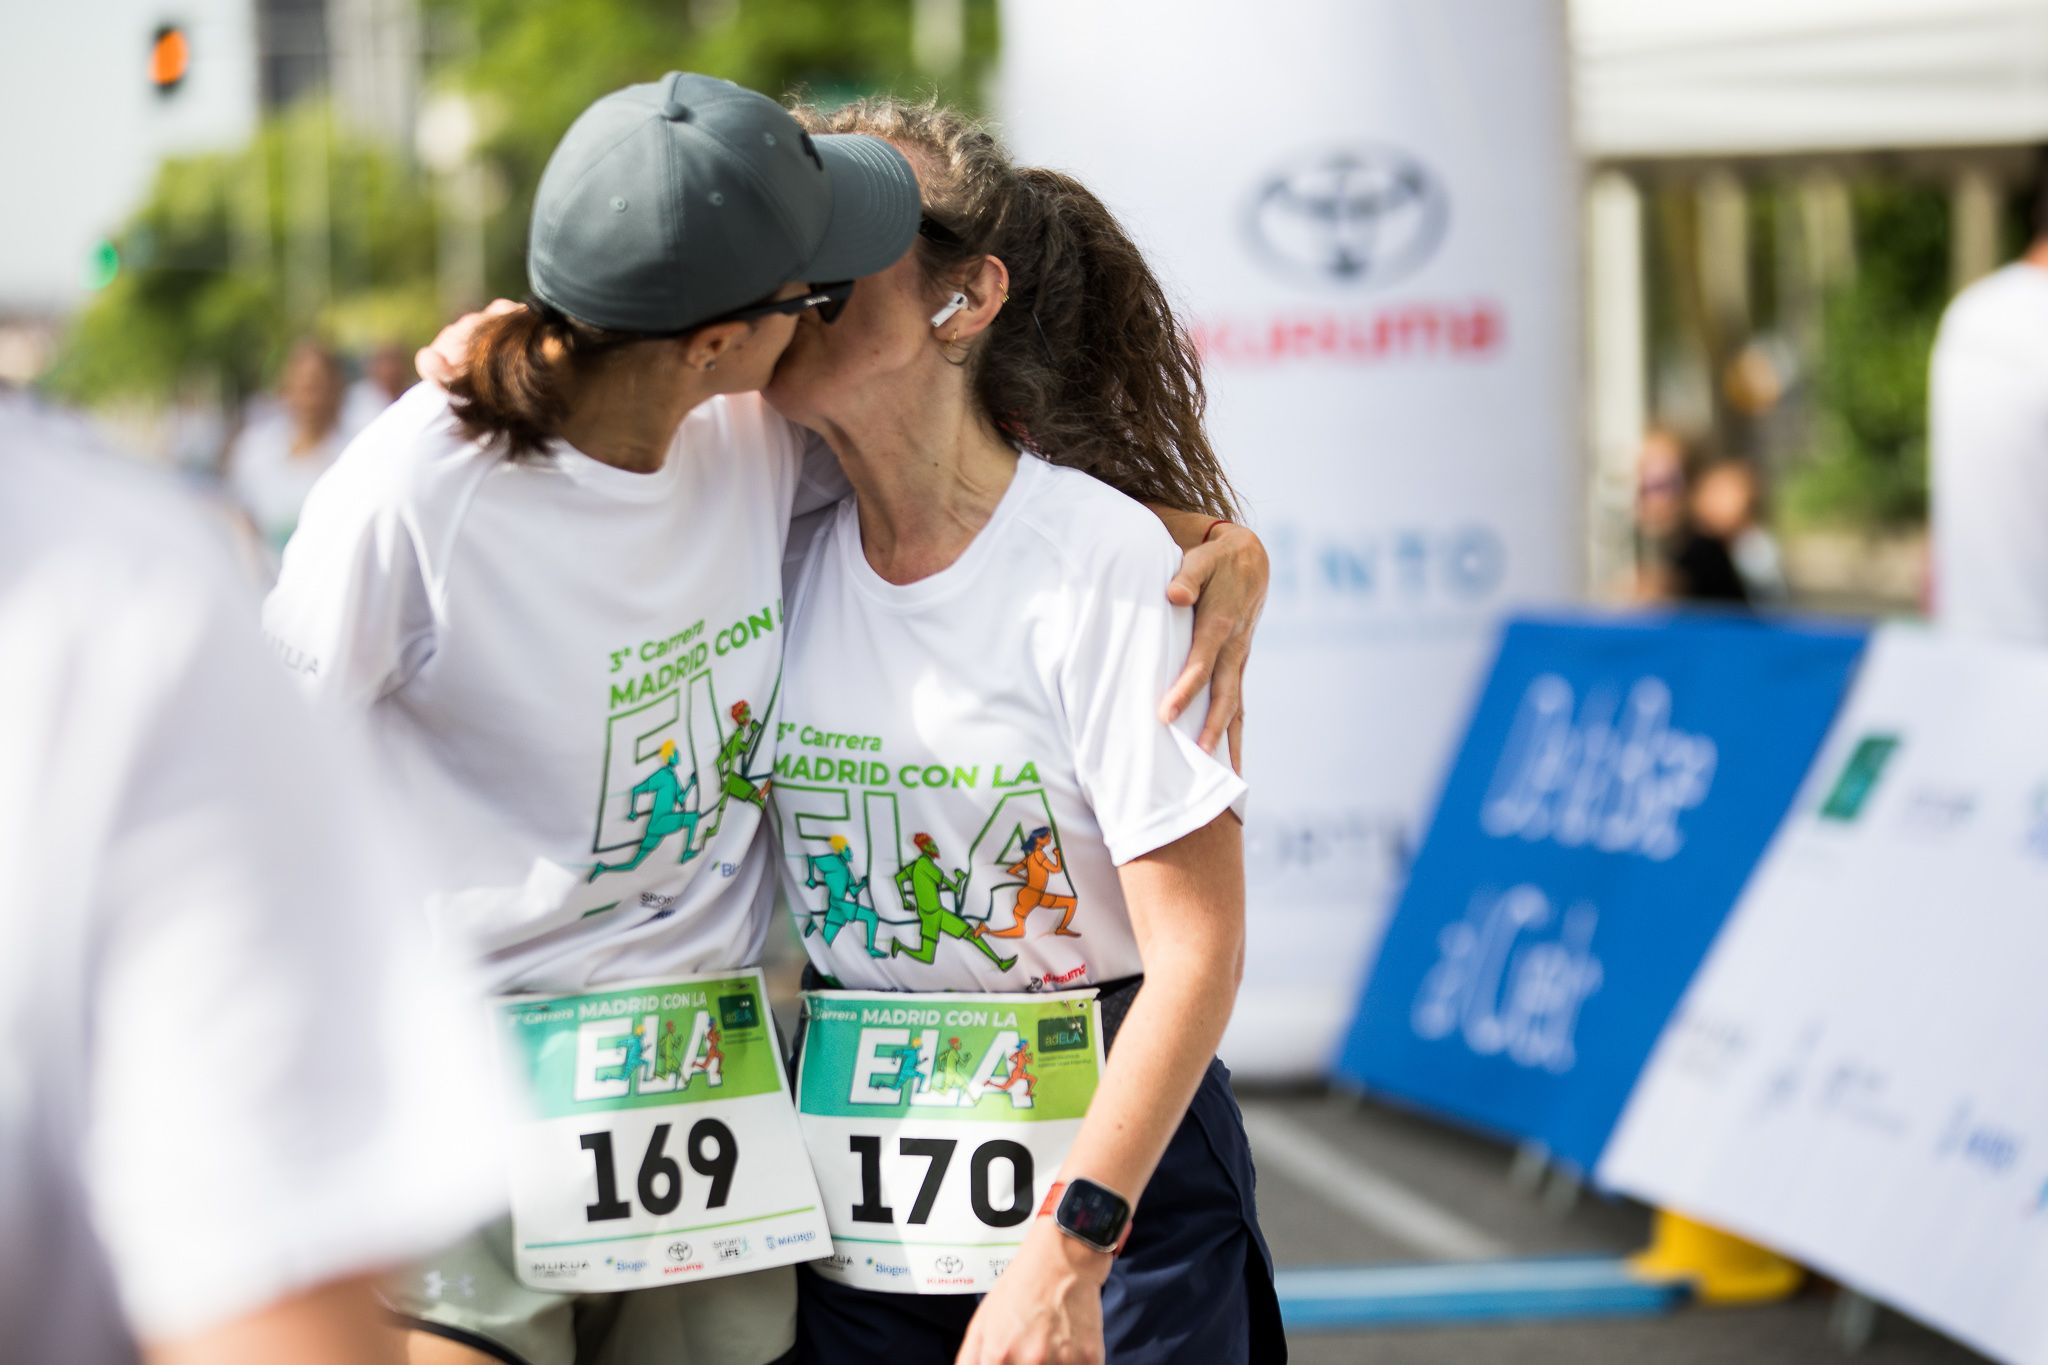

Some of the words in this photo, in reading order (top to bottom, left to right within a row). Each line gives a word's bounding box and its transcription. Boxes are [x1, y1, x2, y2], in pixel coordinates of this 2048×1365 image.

[609, 641, 709, 711] MADRID
[714, 605, 775, 656] CON
[800, 724, 882, 753] Carrera
[898, 764, 980, 790] CON
[991, 760, 1042, 788] LA
[578, 996, 661, 1019] MADRID
[663, 992, 691, 1011] CON
[692, 991, 708, 1008] LA
[861, 1008, 941, 1026] MADRID
[944, 1009, 989, 1028] CON
[991, 1010, 1019, 1028] LA
[573, 1009, 723, 1103] ELA
[849, 1027, 1034, 1110] ELA
[579, 1117, 739, 1223] 169
[849, 1135, 1035, 1228] 170
